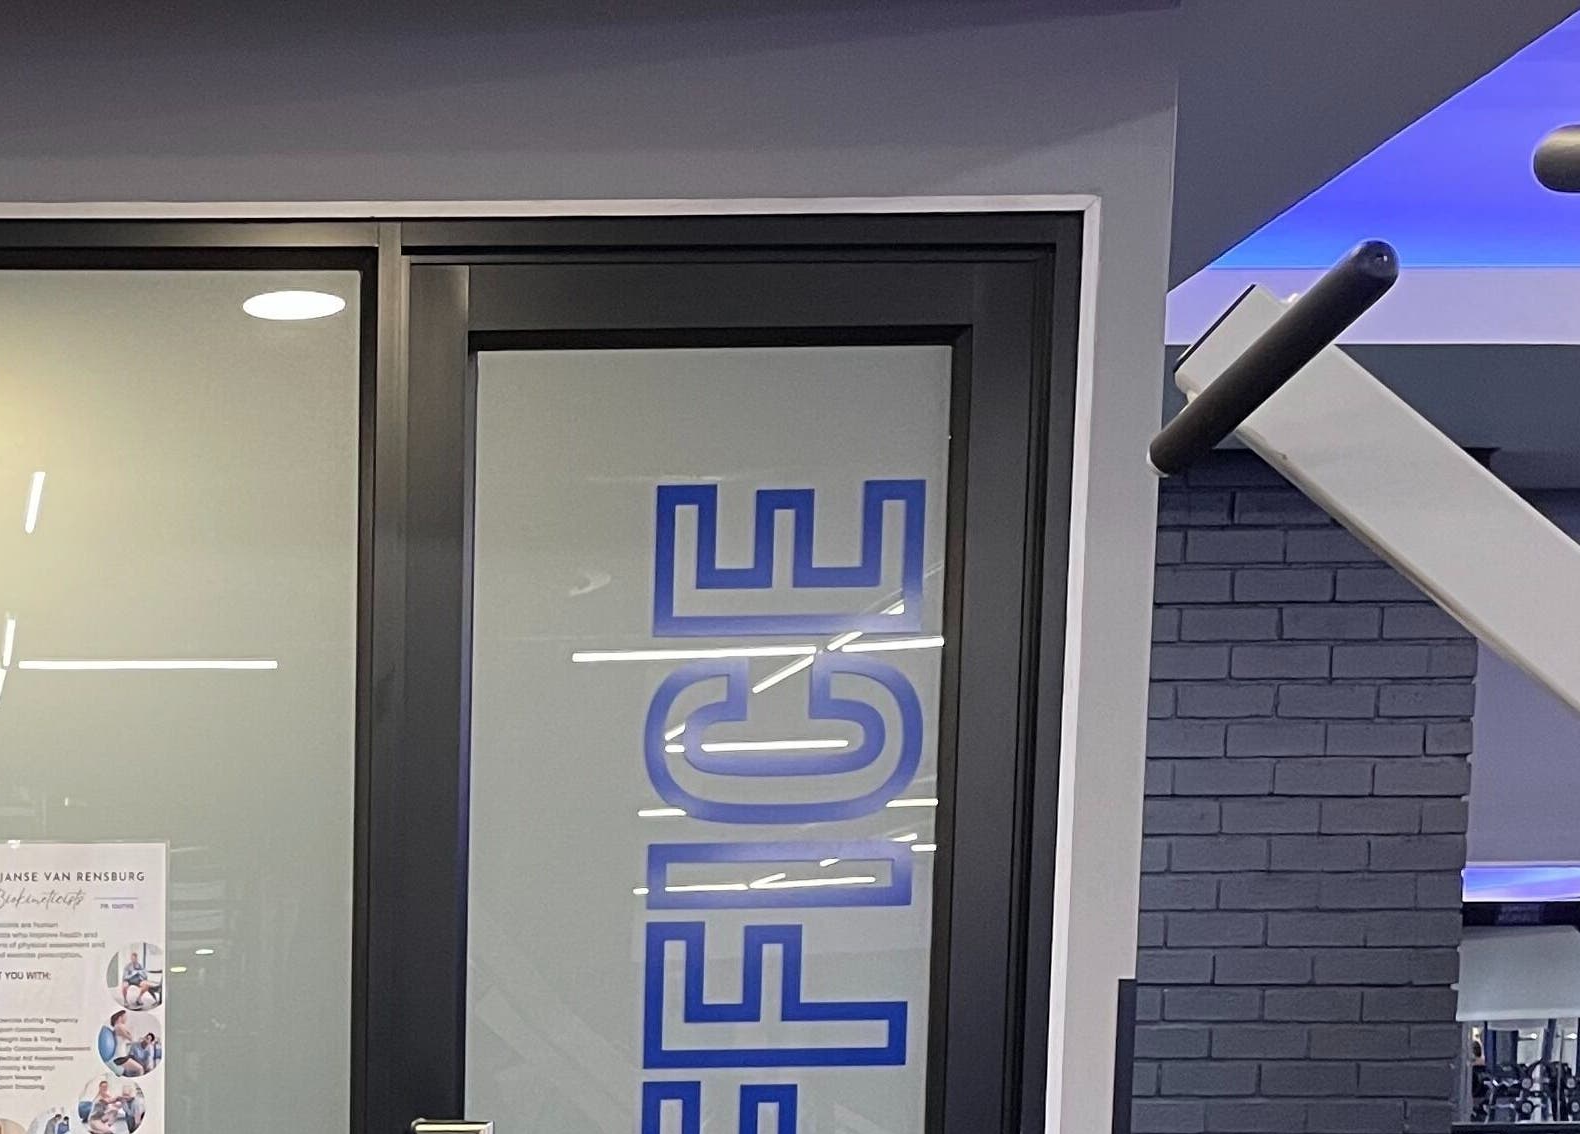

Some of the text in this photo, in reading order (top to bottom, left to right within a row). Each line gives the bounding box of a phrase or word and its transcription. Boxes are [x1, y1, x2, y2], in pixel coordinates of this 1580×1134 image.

[0, 872, 38, 882] JANSE
[44, 872, 71, 882] VAN
[76, 872, 146, 882] RENSBURG
[5, 971, 24, 981] YOU
